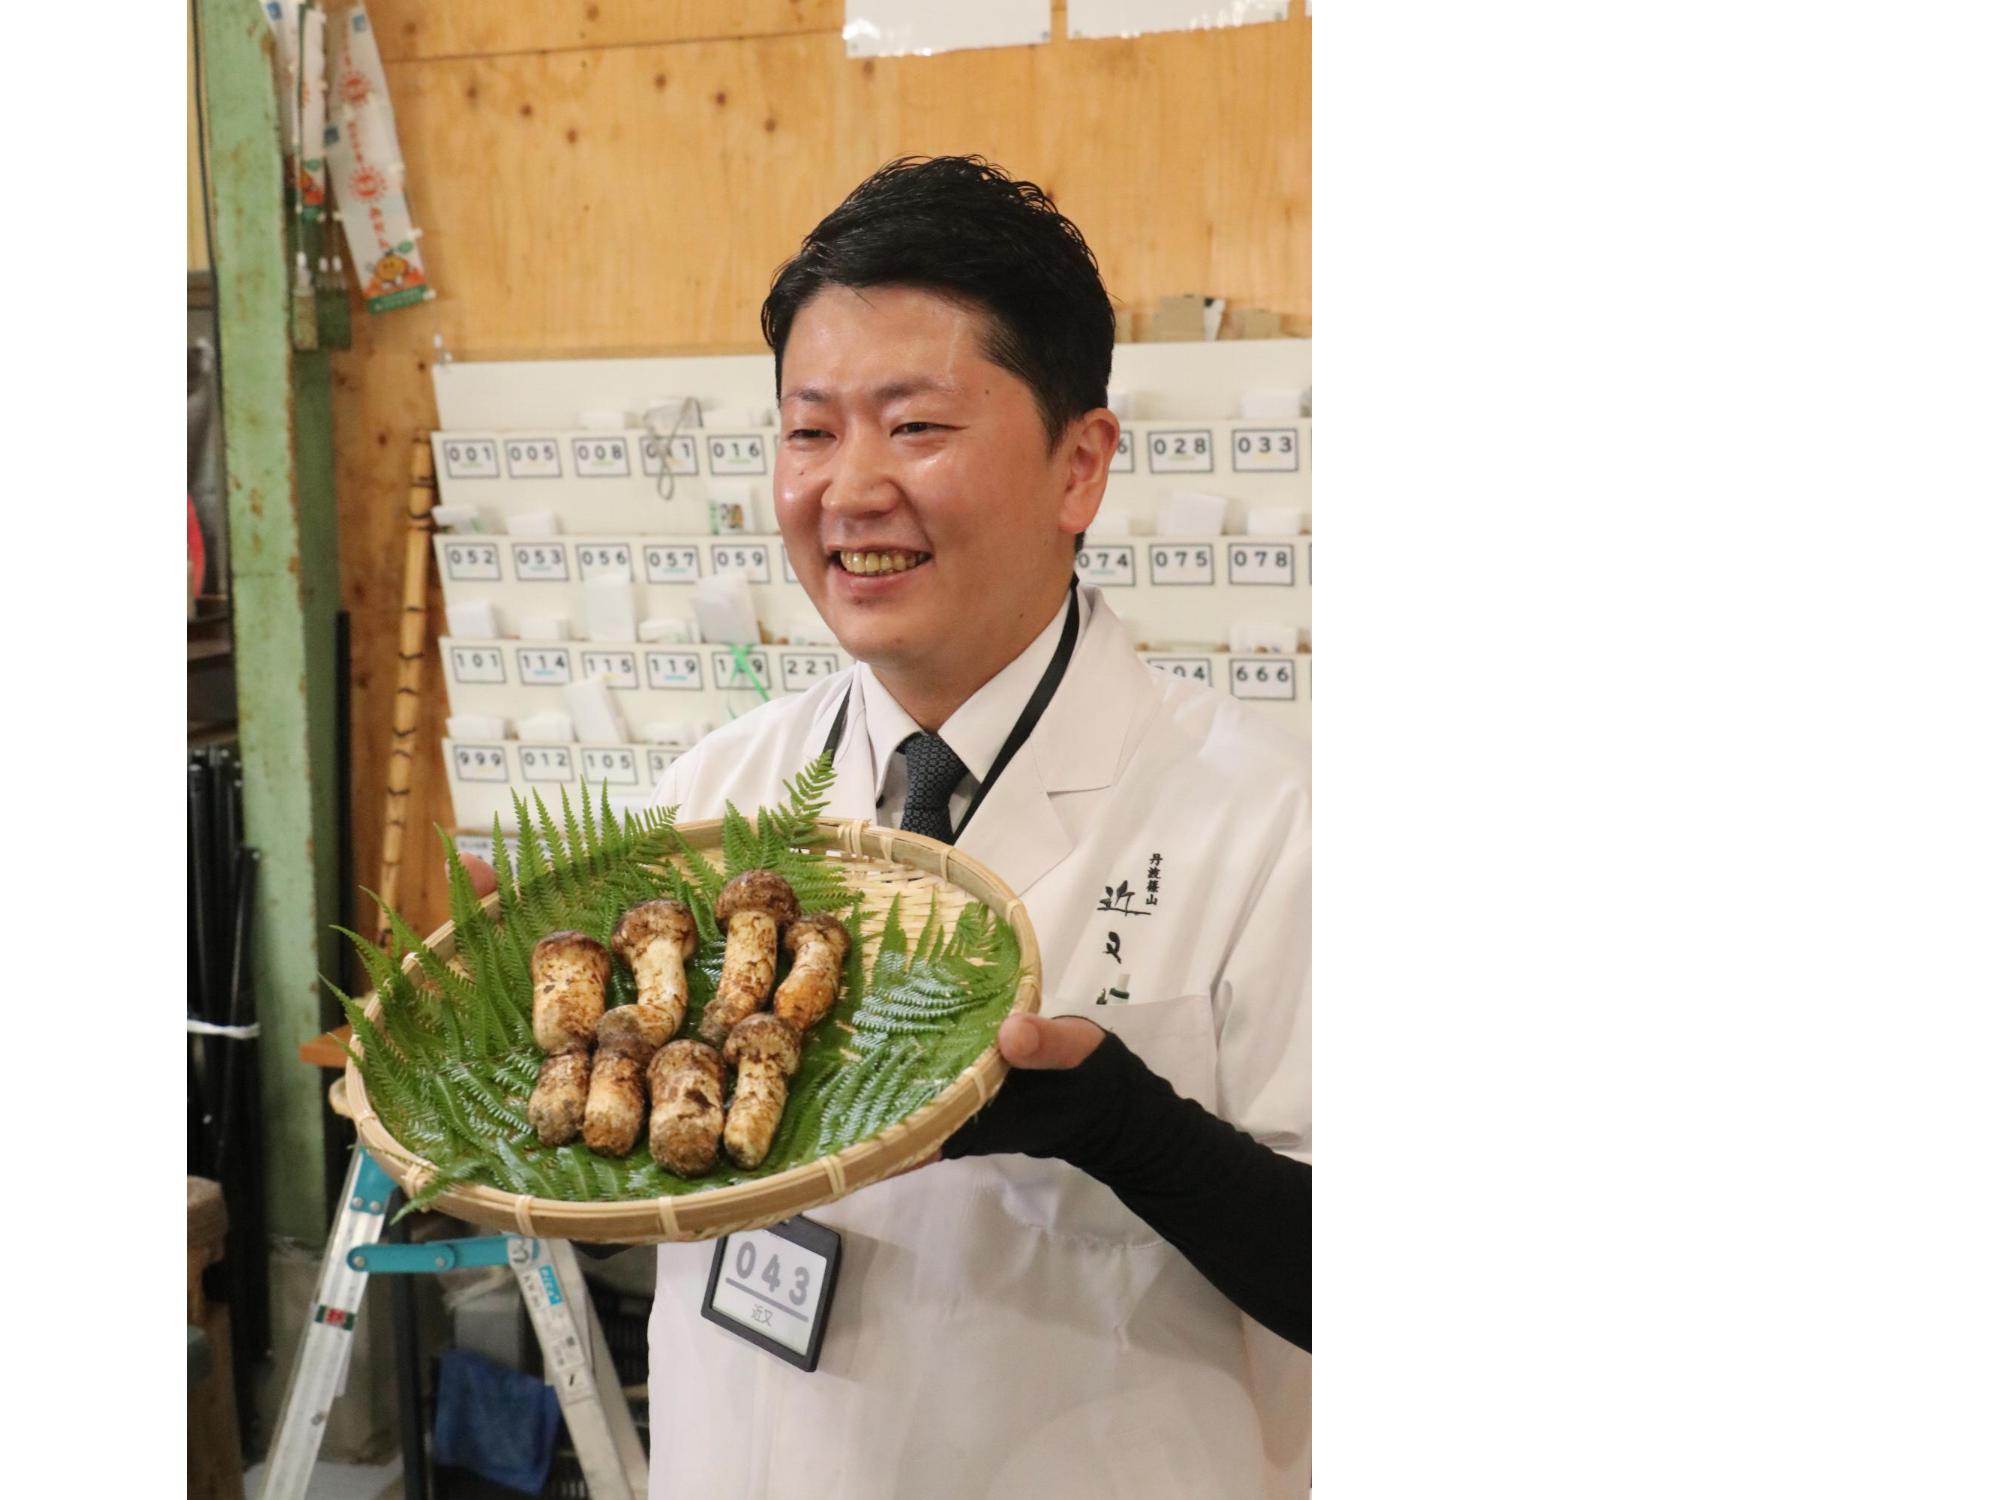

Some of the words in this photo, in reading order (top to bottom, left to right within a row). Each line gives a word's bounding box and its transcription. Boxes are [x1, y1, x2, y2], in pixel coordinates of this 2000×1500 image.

[509, 445, 554, 461] 005
[577, 444, 623, 461] 008
[645, 443, 690, 459] 01
[713, 441, 760, 458] 016
[1152, 439, 1208, 456] 028
[1237, 437, 1293, 453] 033
[449, 446, 491, 462] 001
[450, 550, 494, 566] 052
[518, 549, 563, 565] 053
[581, 551, 627, 566] 056
[648, 551, 695, 568] 057
[716, 551, 764, 568] 059
[1077, 552, 1129, 569] 074
[1154, 551, 1209, 568] 075
[1233, 550, 1288, 568] 078
[456, 652, 499, 668] 101
[521, 654, 566, 669] 114
[587, 657, 632, 673] 115
[651, 657, 697, 675] 119
[718, 658, 763, 673] 19
[786, 659, 834, 676] 221
[1152, 664, 1206, 681] 04
[1235, 666, 1290, 683] 666
[458, 750, 501, 767] 999
[523, 751, 567, 768] 012
[587, 753, 632, 770] 105
[736, 1241, 810, 1306] 043
[751, 1304, 773, 1327] 近又
